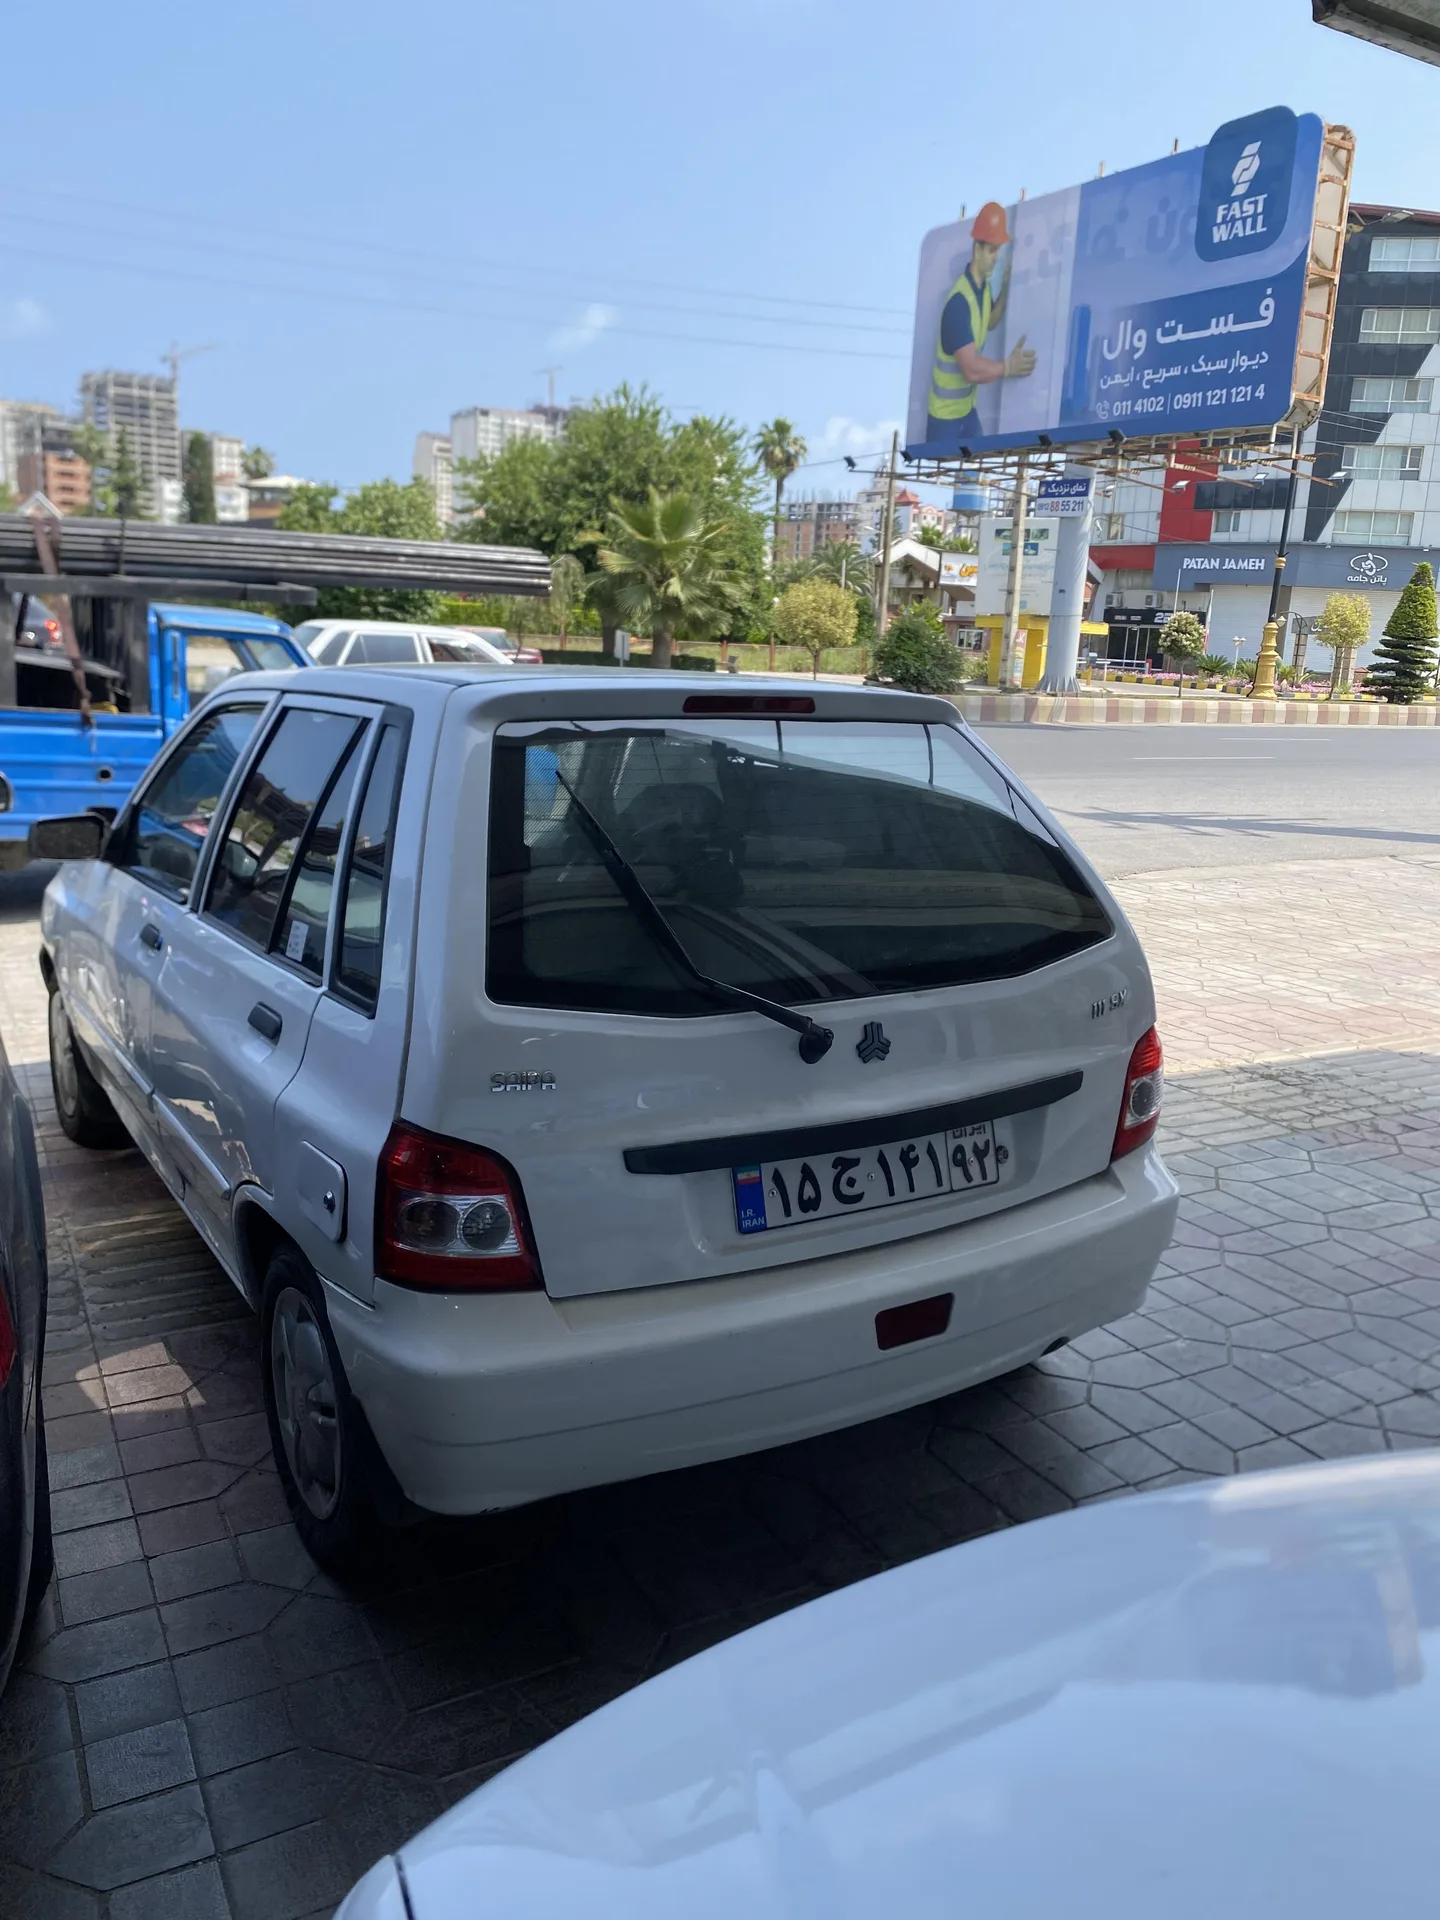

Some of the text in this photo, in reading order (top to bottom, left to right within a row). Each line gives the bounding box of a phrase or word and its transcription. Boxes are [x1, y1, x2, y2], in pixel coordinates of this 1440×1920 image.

[1216, 194, 1267, 223] FAST
[1212, 216, 1267, 244] WALL
[1102, 287, 1275, 361] فست وال
[1228, 350, 1269, 373] دیوار
[1100, 367, 1134, 389] ایمن
[1113, 400, 1131, 416] 011
[1134, 396, 1164, 414] 4102
[1173, 391, 1202, 410] 0911
[1206, 389, 1226, 406] 121
[1050, 500, 1060, 512] 88
[1061, 500, 1070, 511] 55
[1071, 500, 1084, 511] 211
[1183, 557, 1265, 570] PATAN JAMEH
[1347, 574, 1387, 586] پاتن جامه
[490, 1070, 557, 1092] SAIPA
[741, 1208, 756, 1219] I.R.
[742, 1216, 765, 1229] IRAN
